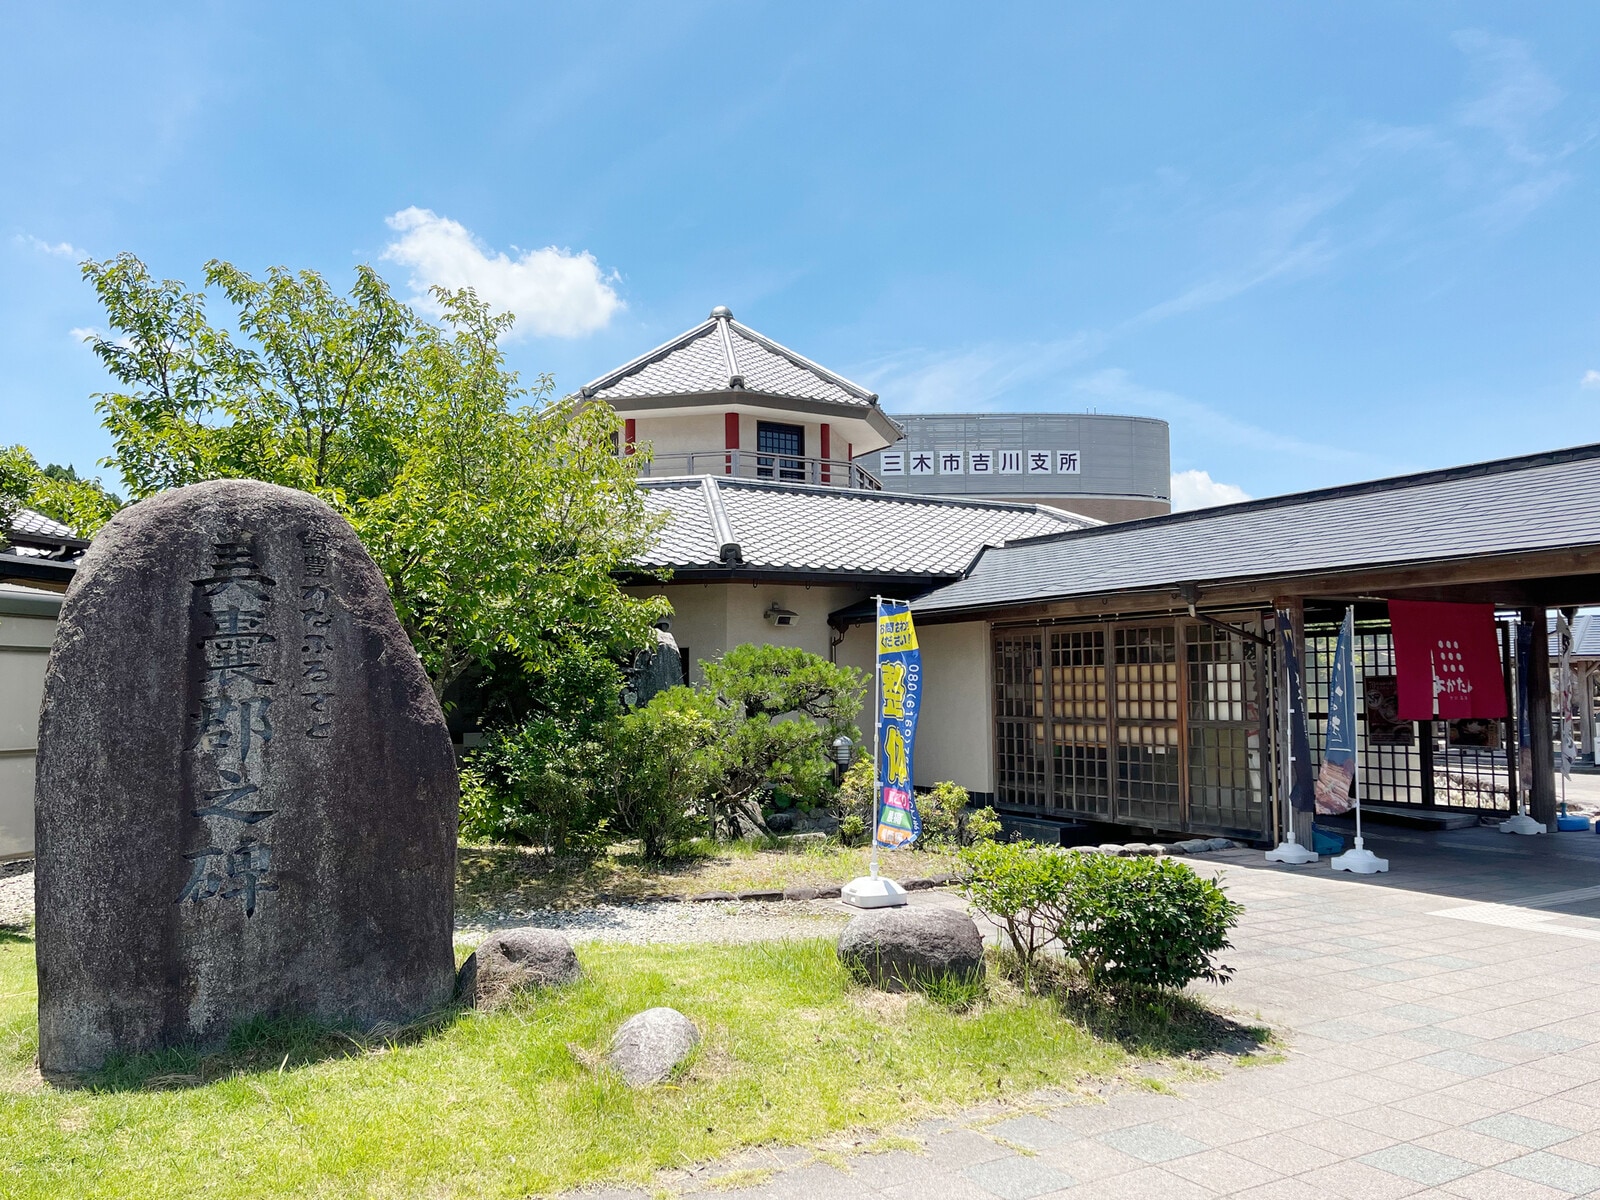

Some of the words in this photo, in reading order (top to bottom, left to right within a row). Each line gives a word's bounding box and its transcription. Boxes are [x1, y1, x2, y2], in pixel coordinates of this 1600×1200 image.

[884, 453, 1077, 472] 三木市吉川支所
[880, 621, 909, 635] お問合わ
